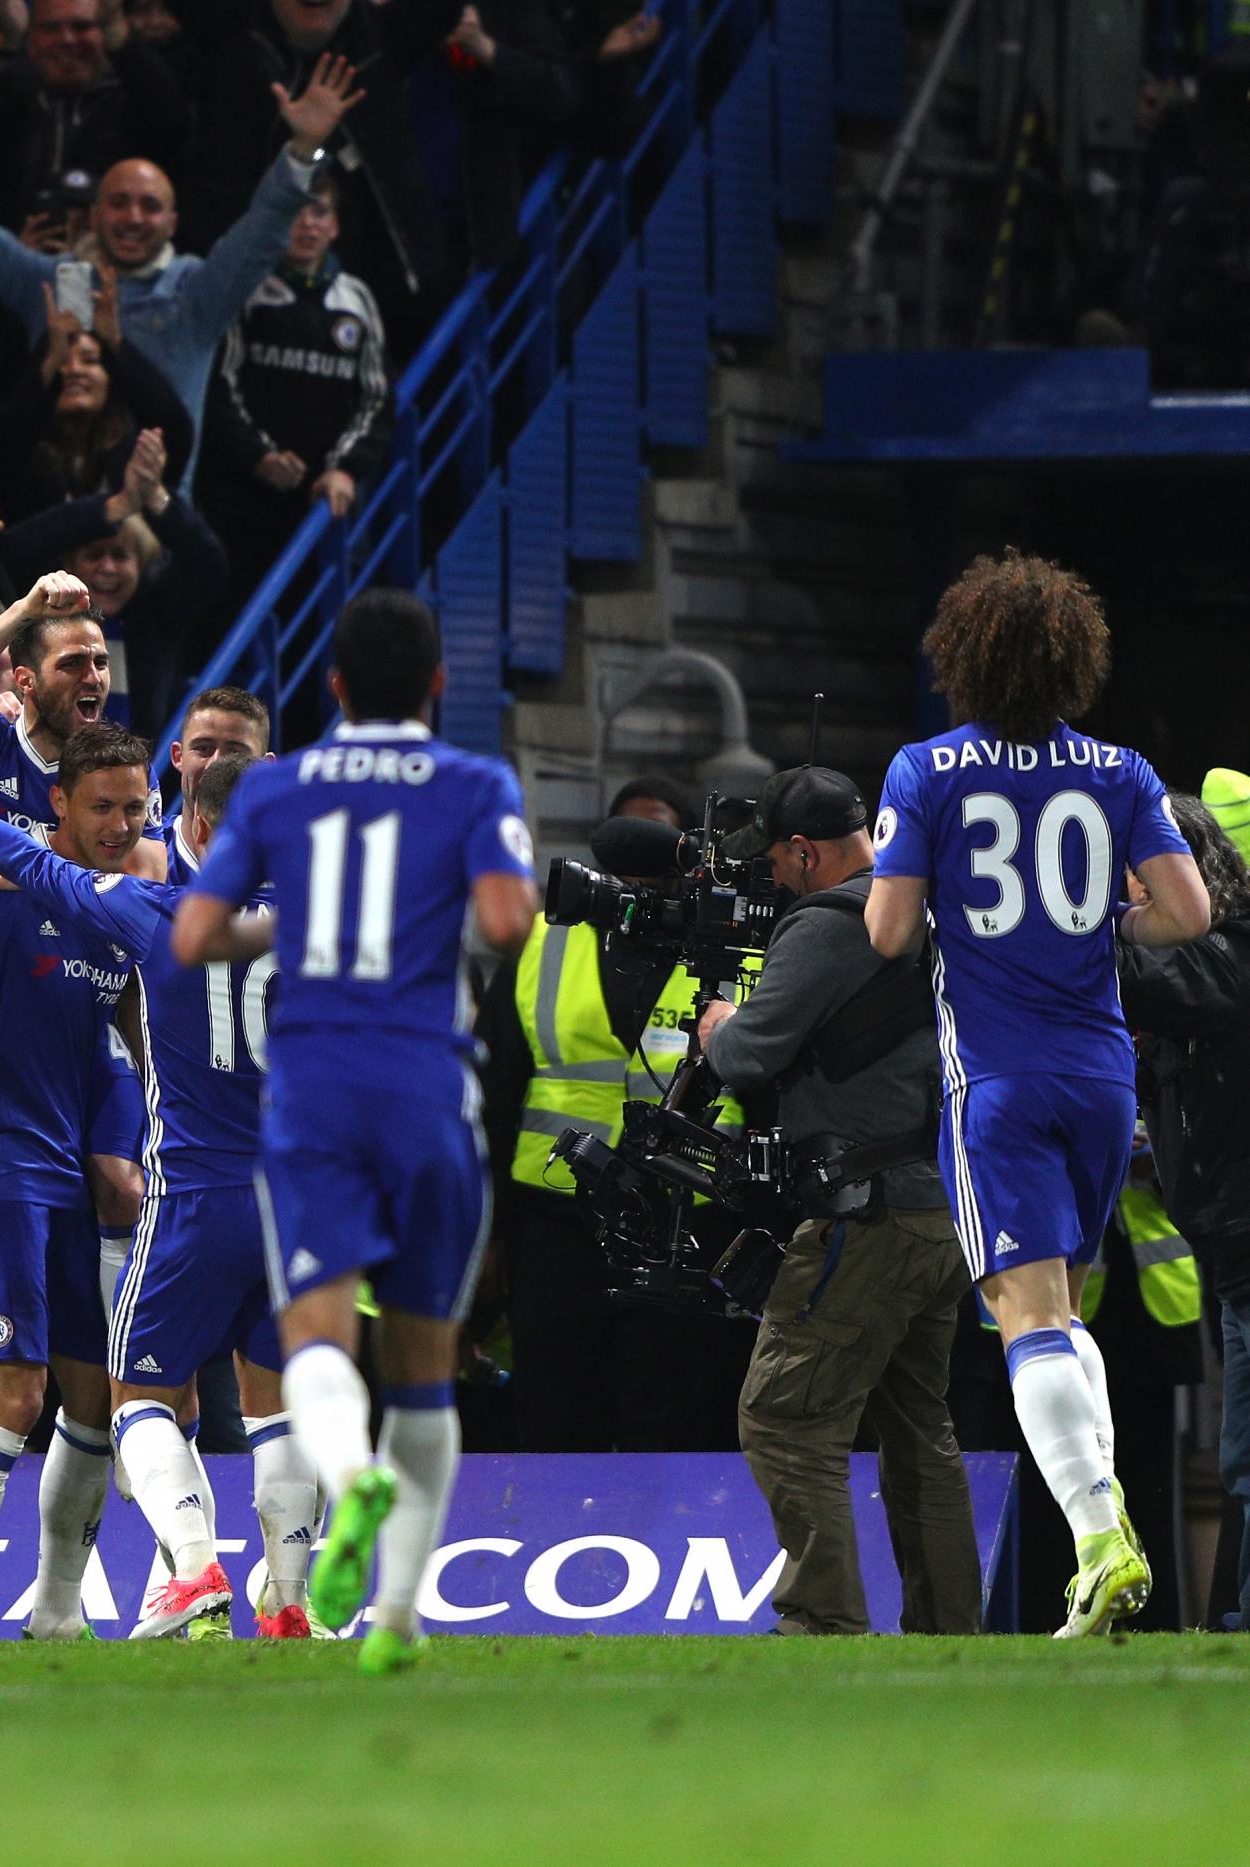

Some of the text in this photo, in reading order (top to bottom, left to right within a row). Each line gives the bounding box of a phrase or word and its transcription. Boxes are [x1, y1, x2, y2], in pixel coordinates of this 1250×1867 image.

[251, 343, 356, 379] SAMSUN
[299, 746, 435, 785] PEDRO
[931, 740, 1122, 771] DAVID LUIZ
[961, 789, 1112, 939] 30
[303, 807, 401, 981] 11
[133, 1363, 163, 1373] adidas
